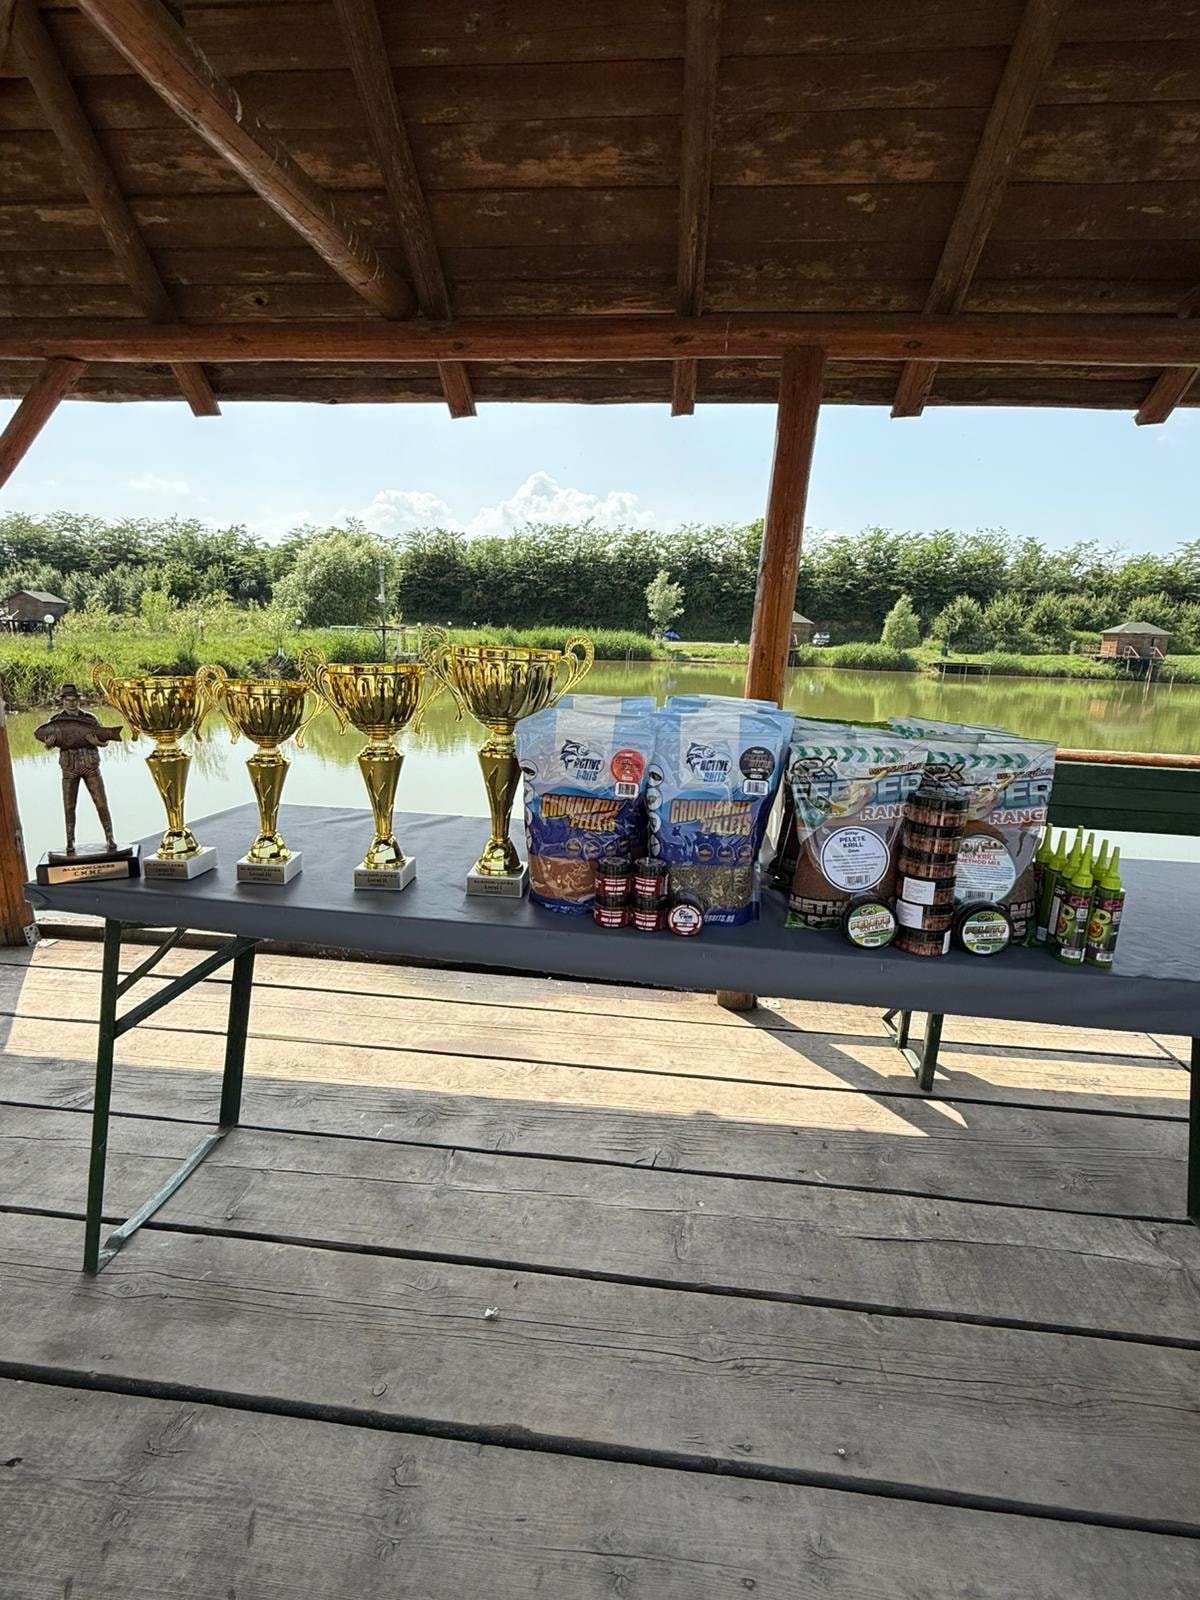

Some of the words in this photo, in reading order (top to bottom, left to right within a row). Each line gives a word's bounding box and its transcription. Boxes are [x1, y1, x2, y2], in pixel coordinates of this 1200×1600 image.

[574, 758, 601, 770] ACTIVE
[700, 760, 728, 771] ACTIVE
[541, 794, 623, 818] GROUNDBAIT
[671, 800, 752, 824] GROUNDBAIT
[790, 893, 850, 915] METH
